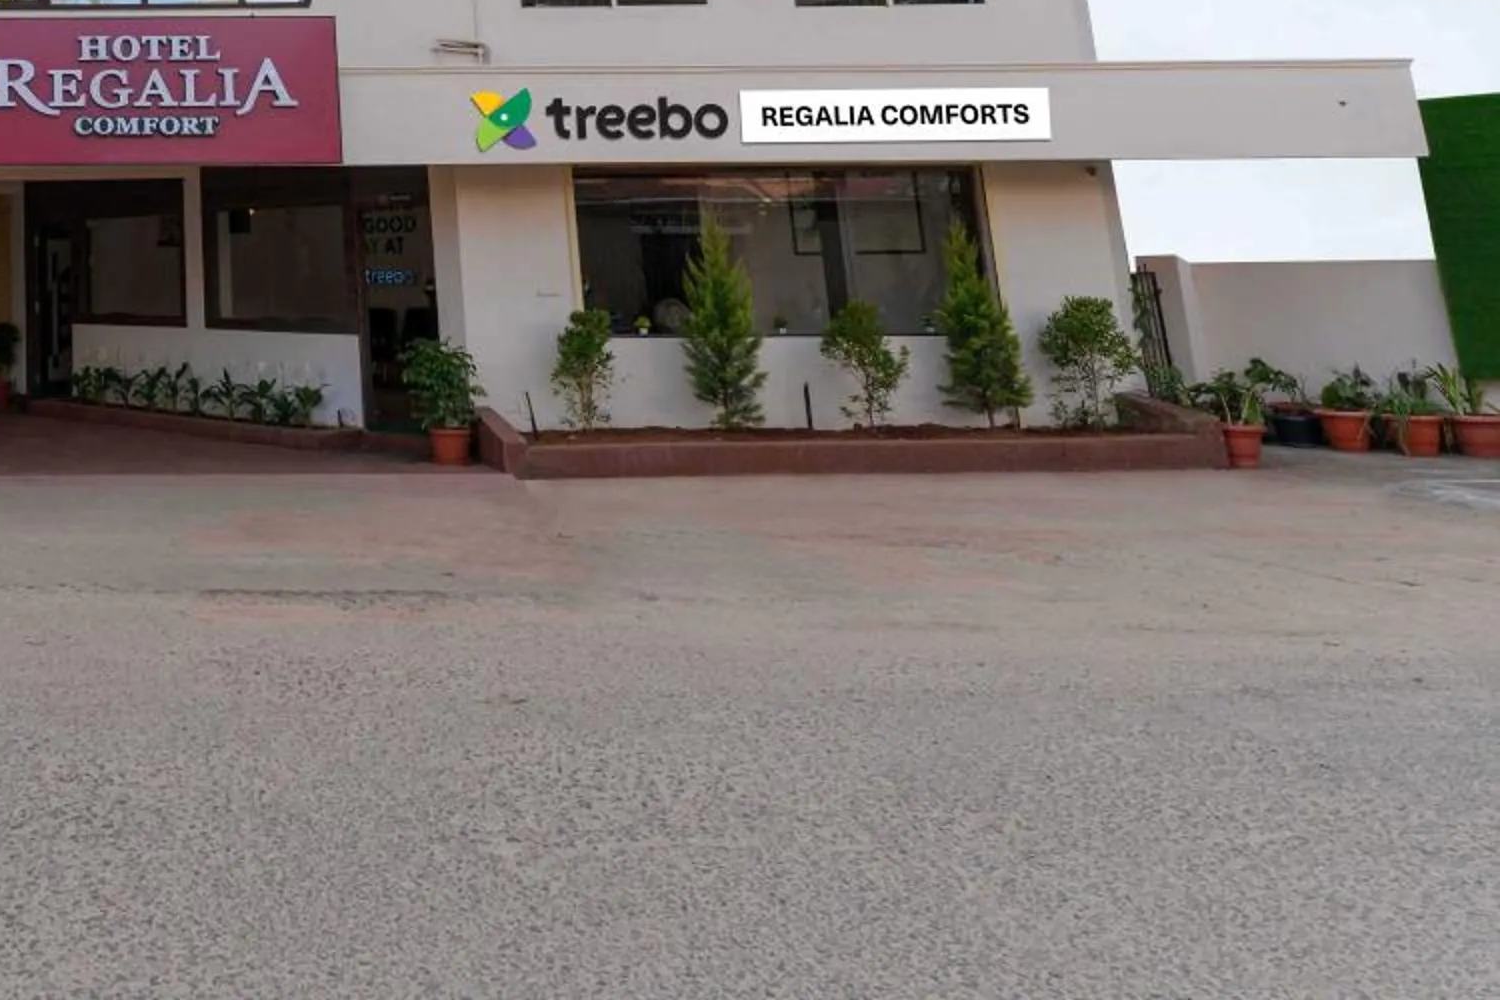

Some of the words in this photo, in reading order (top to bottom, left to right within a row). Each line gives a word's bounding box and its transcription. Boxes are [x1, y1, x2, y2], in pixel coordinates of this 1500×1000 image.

[78, 35, 221, 61] HOTEL
[74, 116, 219, 136] COMFORT
[545, 96, 729, 141] treebo
[761, 105, 875, 127] REGALIA
[880, 103, 1030, 126] COMFORTS
[362, 215, 417, 234] GOOD
